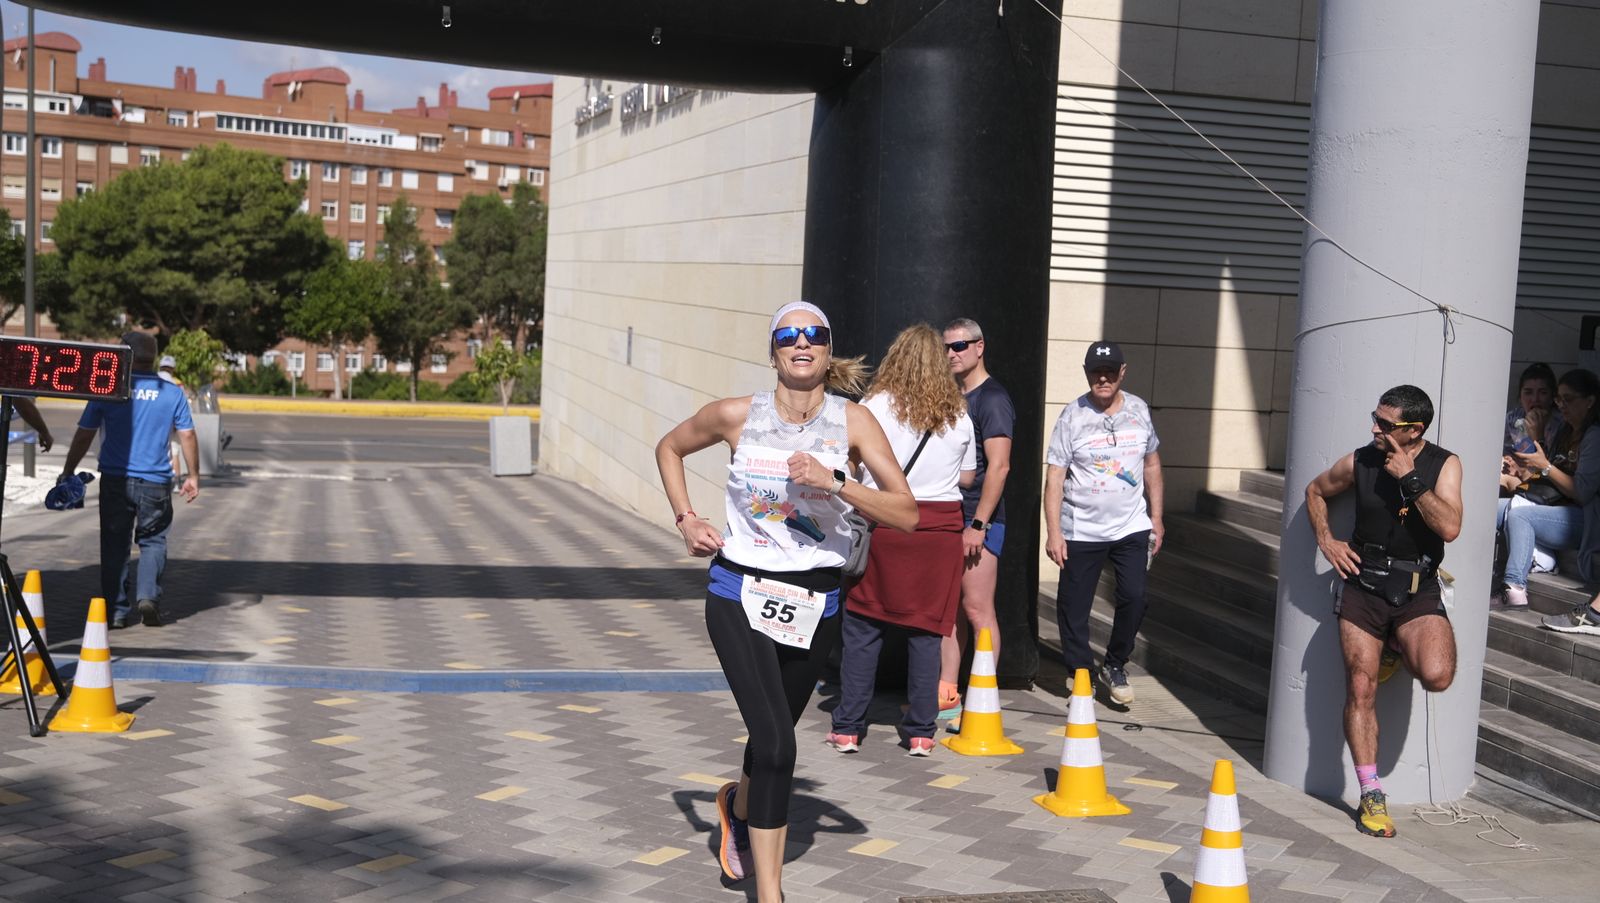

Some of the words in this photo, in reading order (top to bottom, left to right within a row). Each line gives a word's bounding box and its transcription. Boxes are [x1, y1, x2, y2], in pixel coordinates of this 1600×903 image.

[17, 344, 118, 394] 7:28
[753, 458, 788, 470] CARRER
[760, 599, 797, 624] 55
